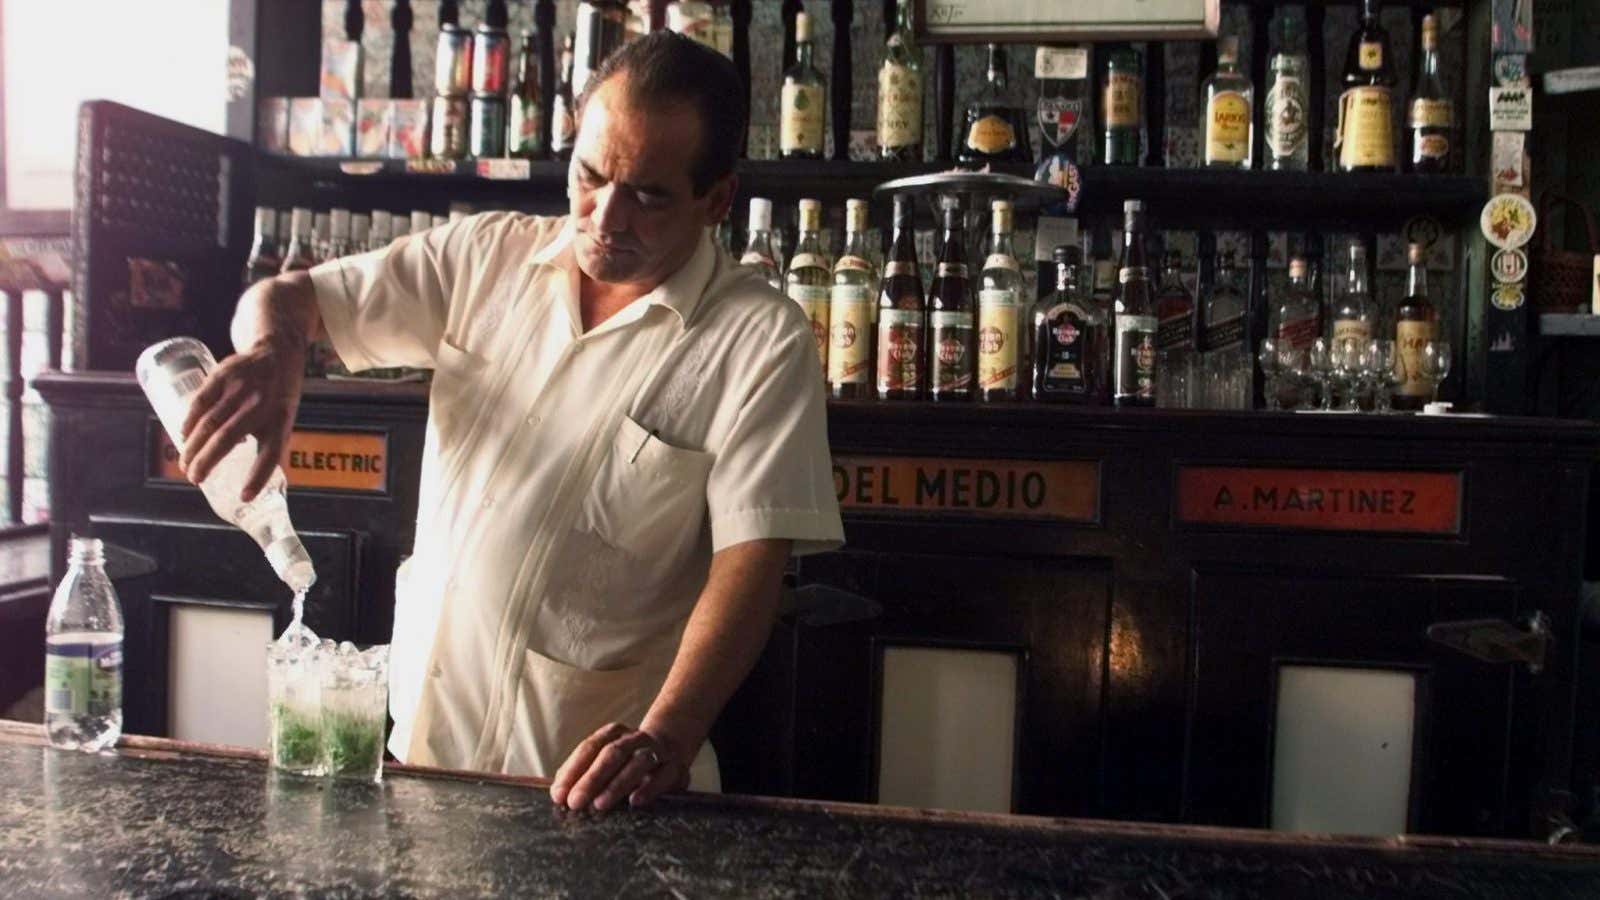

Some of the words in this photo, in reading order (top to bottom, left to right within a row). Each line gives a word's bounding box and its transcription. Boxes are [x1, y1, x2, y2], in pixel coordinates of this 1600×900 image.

[289, 451, 381, 474] ELECTRIC
[832, 464, 899, 504] DEL
[915, 467, 1047, 509] MEDIO
